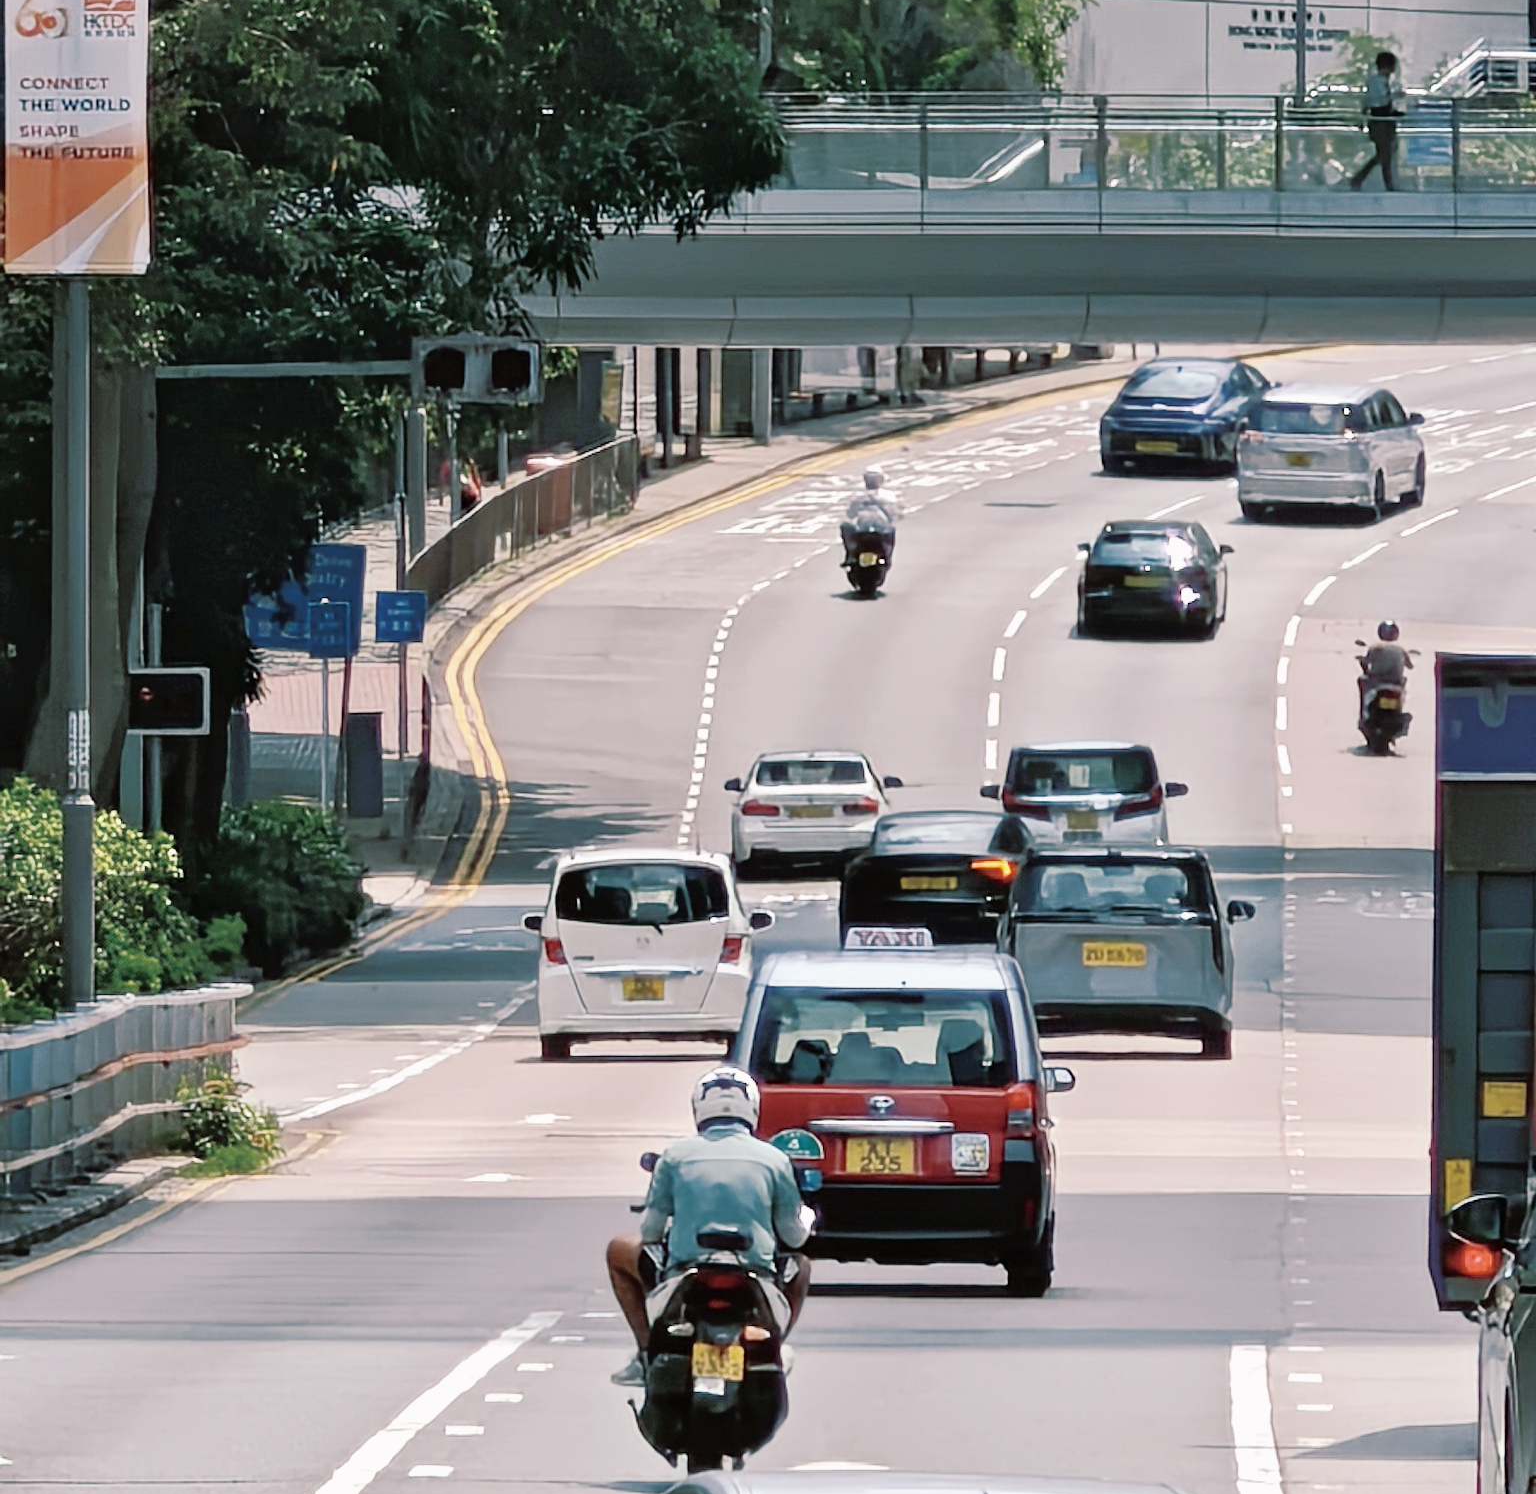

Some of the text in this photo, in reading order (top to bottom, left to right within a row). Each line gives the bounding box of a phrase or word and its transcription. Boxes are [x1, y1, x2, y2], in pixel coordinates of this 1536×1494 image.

[20, 77, 109, 90] CONNECT
[19, 98, 131, 112] THE WORLD
[20, 125, 79, 138] SHAPE
[20, 146, 134, 160] THE FUTURE
[853, 930, 925, 947] TAXI
